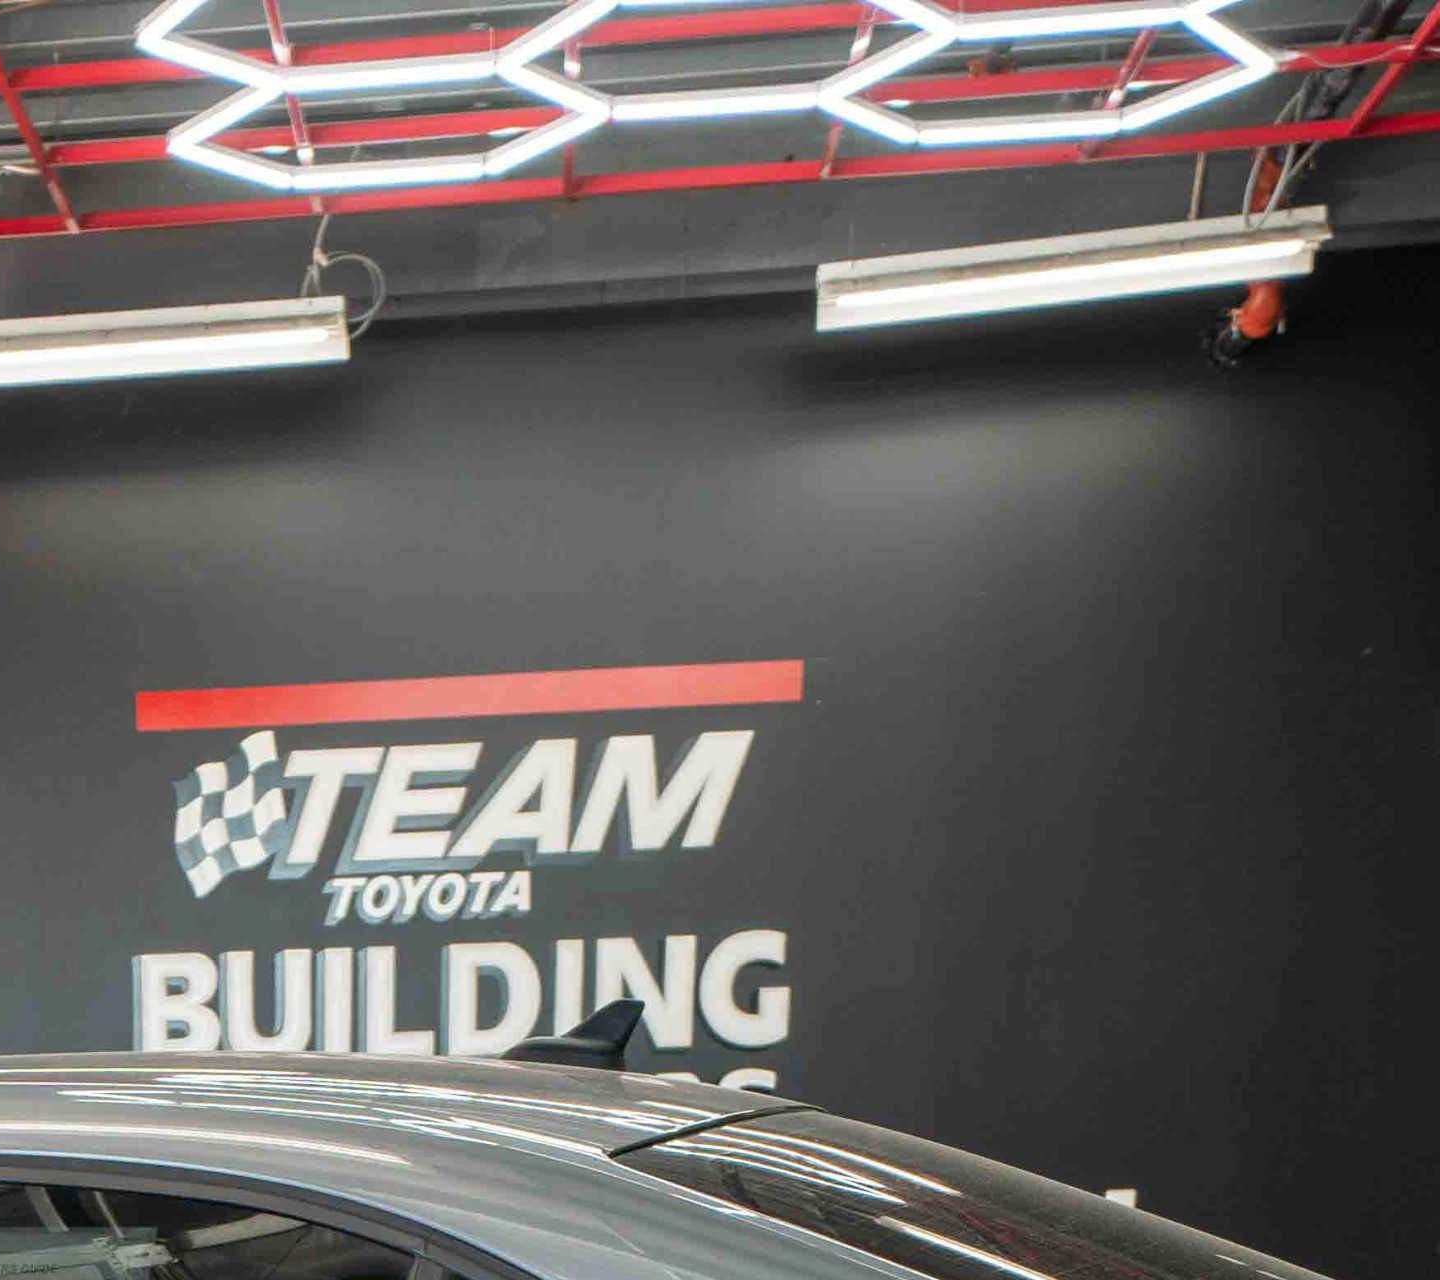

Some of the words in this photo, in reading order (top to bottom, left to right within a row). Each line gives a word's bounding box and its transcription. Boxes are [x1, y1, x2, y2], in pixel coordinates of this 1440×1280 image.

[272, 730, 755, 872] TEAM
[325, 870, 532, 926] TOYOTA
[134, 930, 791, 1056] BUILDING
